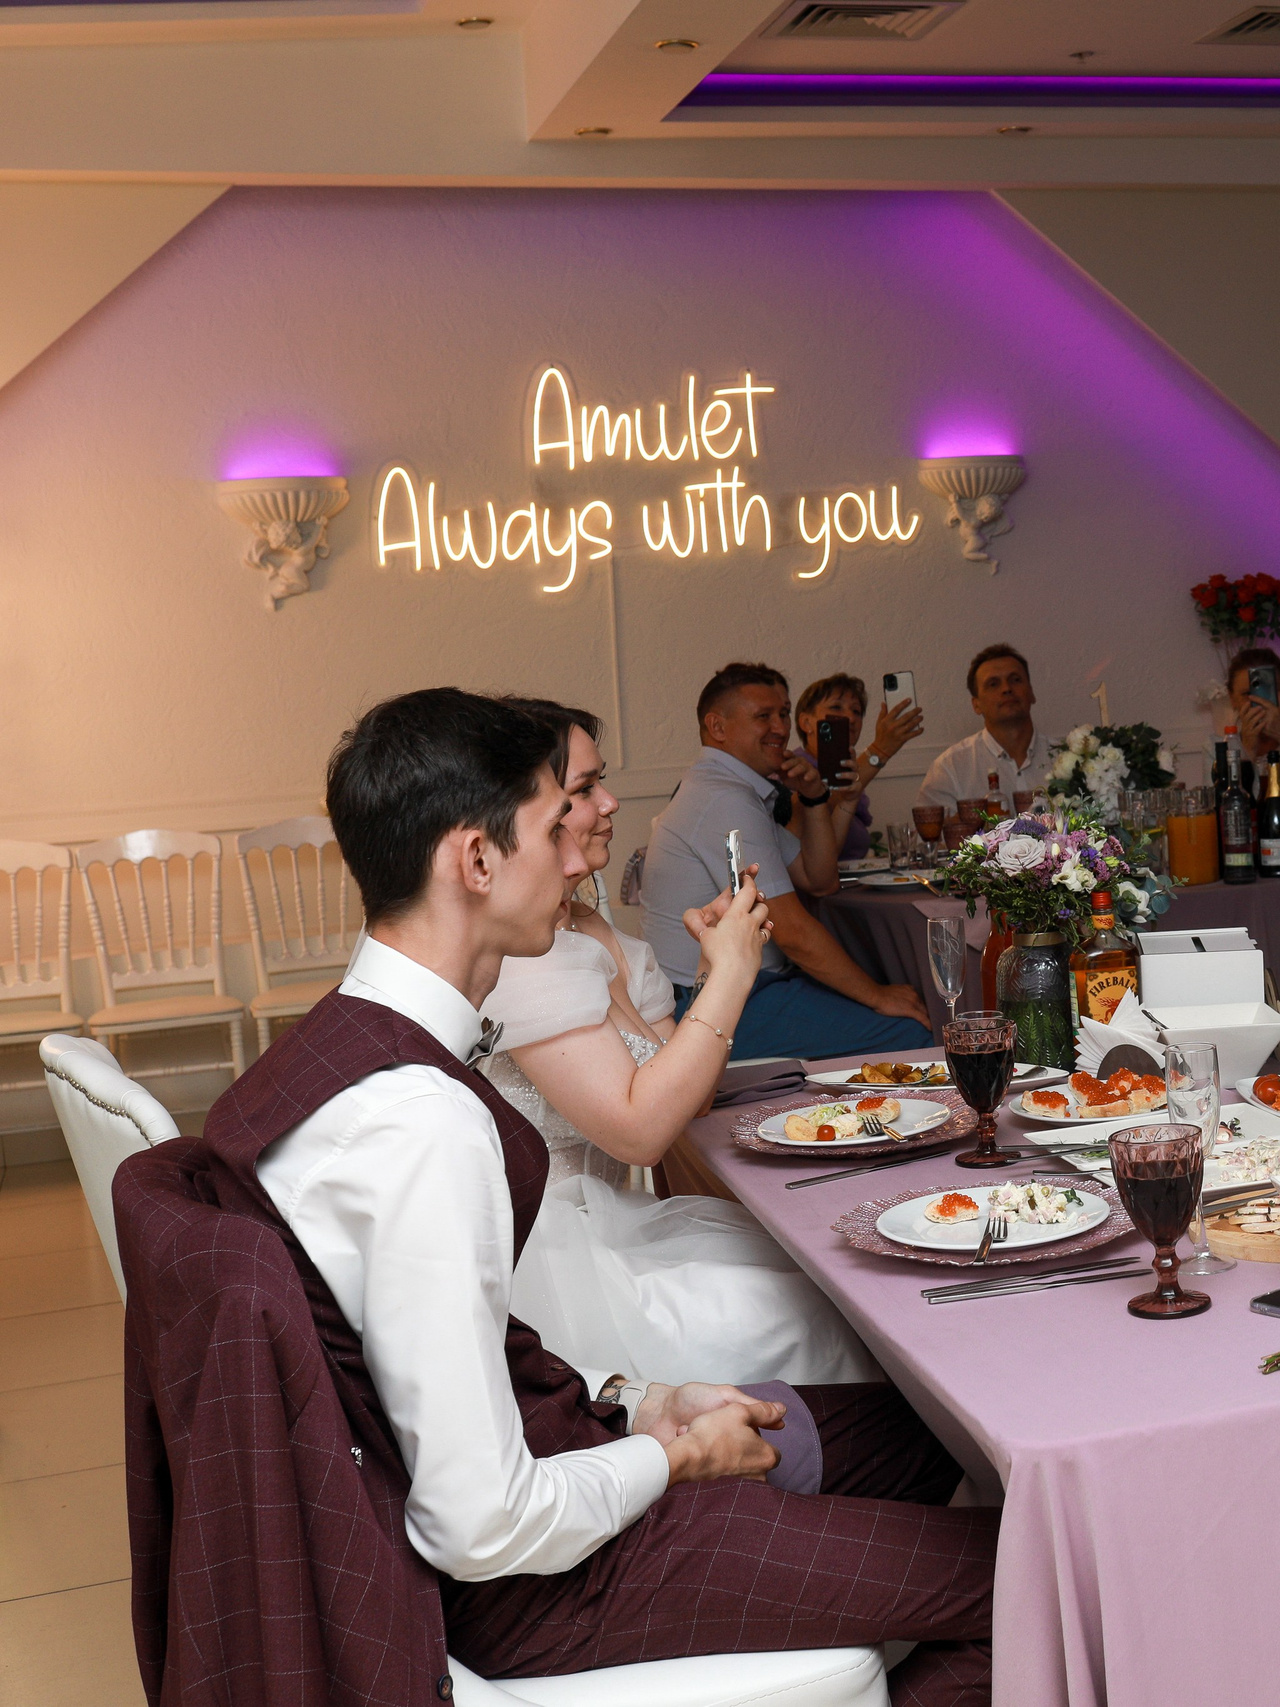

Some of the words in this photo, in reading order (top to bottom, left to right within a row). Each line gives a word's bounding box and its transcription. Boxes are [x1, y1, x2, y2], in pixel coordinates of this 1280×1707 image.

[532, 367, 775, 470] Amulet
[376, 466, 613, 593] Always
[641, 466, 772, 558] with
[797, 485, 919, 579] you
